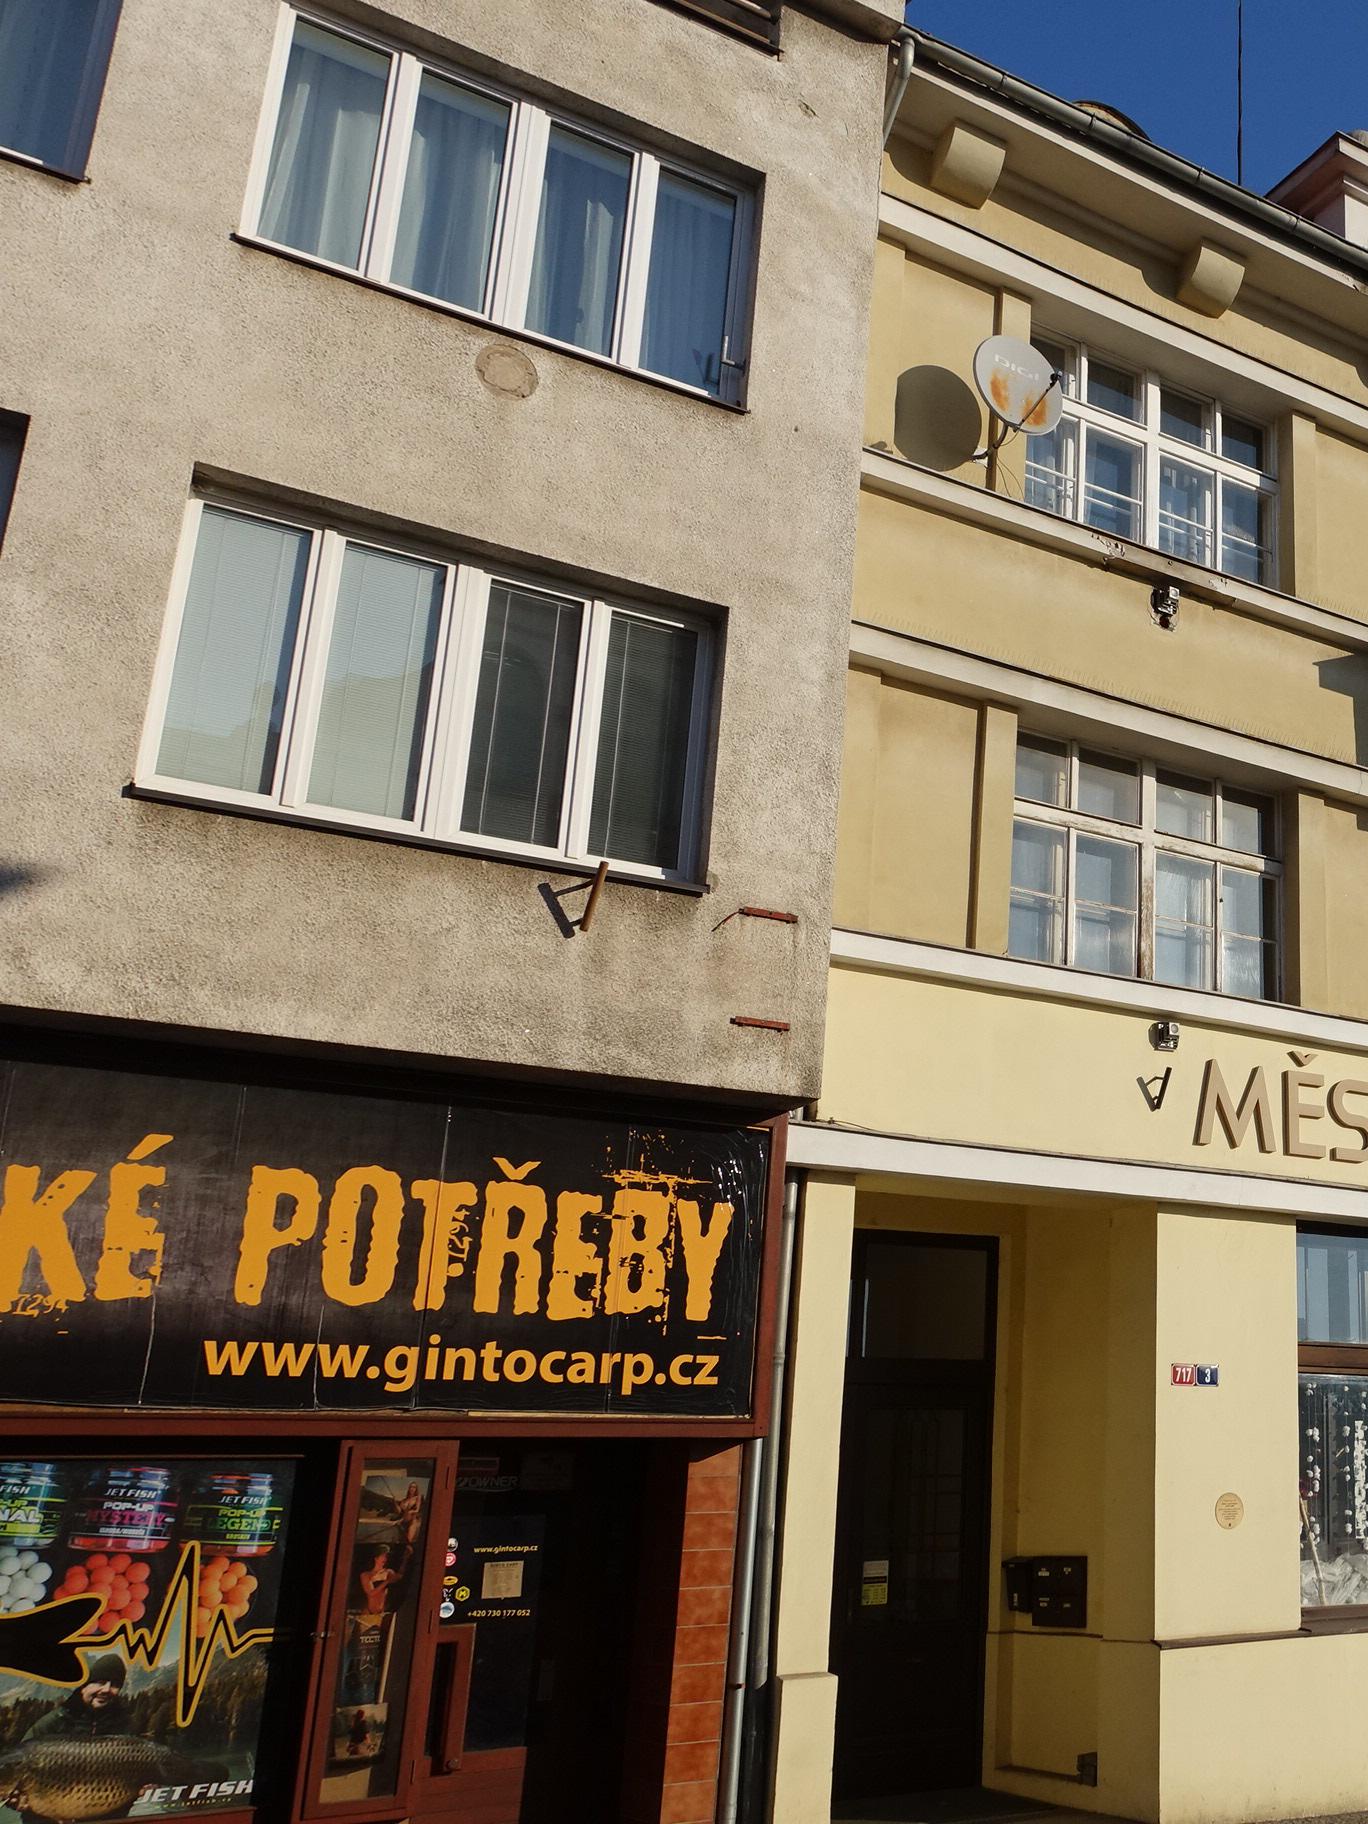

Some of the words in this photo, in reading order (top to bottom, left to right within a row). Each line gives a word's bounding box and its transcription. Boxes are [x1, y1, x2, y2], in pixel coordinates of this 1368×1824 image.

[234, 1157, 735, 1322] POTŘEBY
[203, 1335, 720, 1396] www.gintocarp.cz
[1175, 1367, 1192, 1383] 717
[1204, 1368, 1211, 1383] 3
[127, 1488, 158, 1499] FISH
[102, 1501, 154, 1512] POP-UP
[474, 1545, 538, 1555] www.gintocarp.cz
[467, 1609, 487, 1617] +420
[487, 1609, 502, 1617] 730
[502, 1609, 516, 1617] 177
[516, 1608, 531, 1617] 052
[133, 1784, 188, 1805] JET
[189, 1779, 254, 1800] FISH
